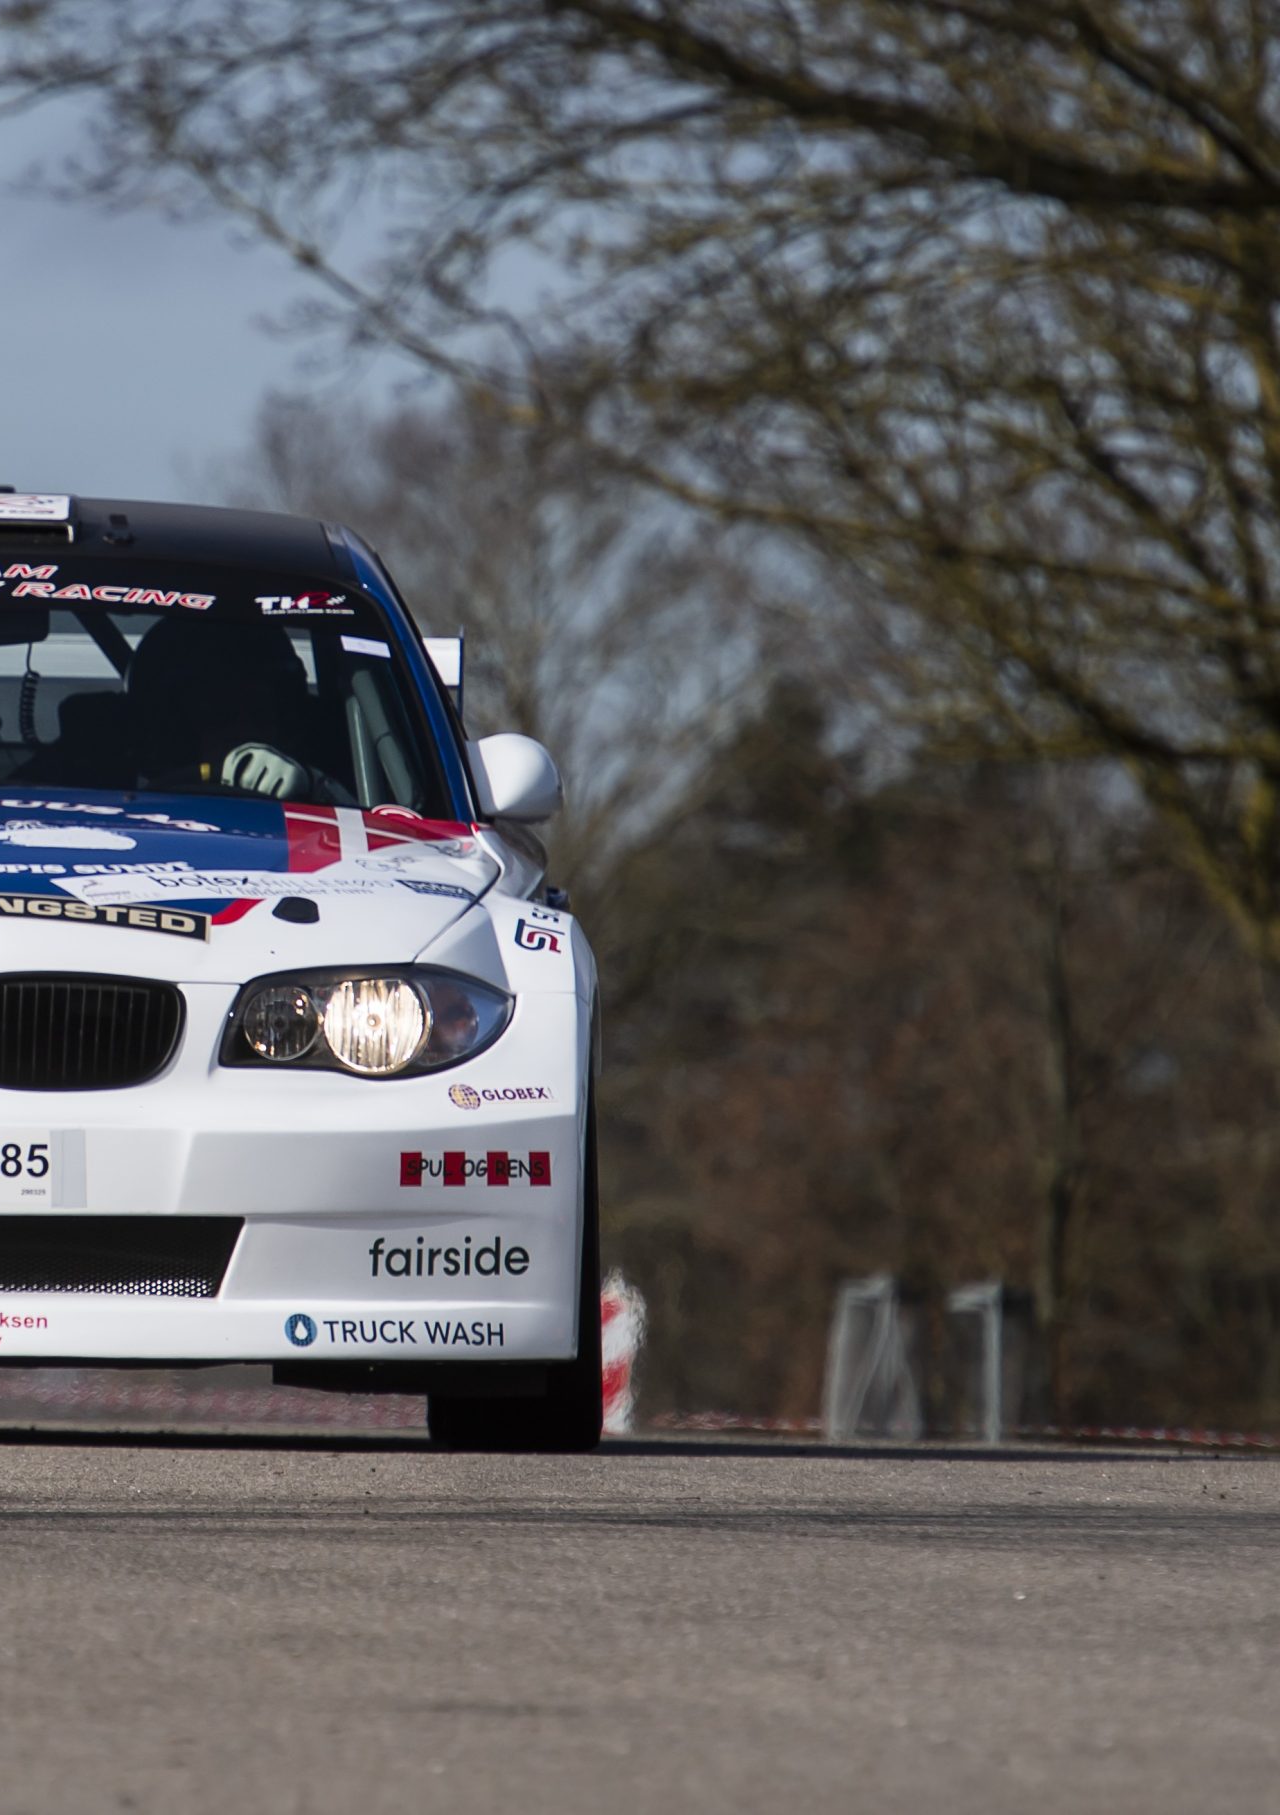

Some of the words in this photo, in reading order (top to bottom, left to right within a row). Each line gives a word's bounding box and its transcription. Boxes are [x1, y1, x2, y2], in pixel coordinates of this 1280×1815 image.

[11, 581, 216, 611] RACING
[481, 1087, 549, 1102] GLOBEX
[406, 1159, 453, 1178] SPUL
[461, 1159, 488, 1178] OG
[495, 1159, 545, 1178] RENS
[369, 1236, 531, 1277] fairside
[323, 1320, 417, 1344] TRUCK
[424, 1321, 505, 1346] WASH
